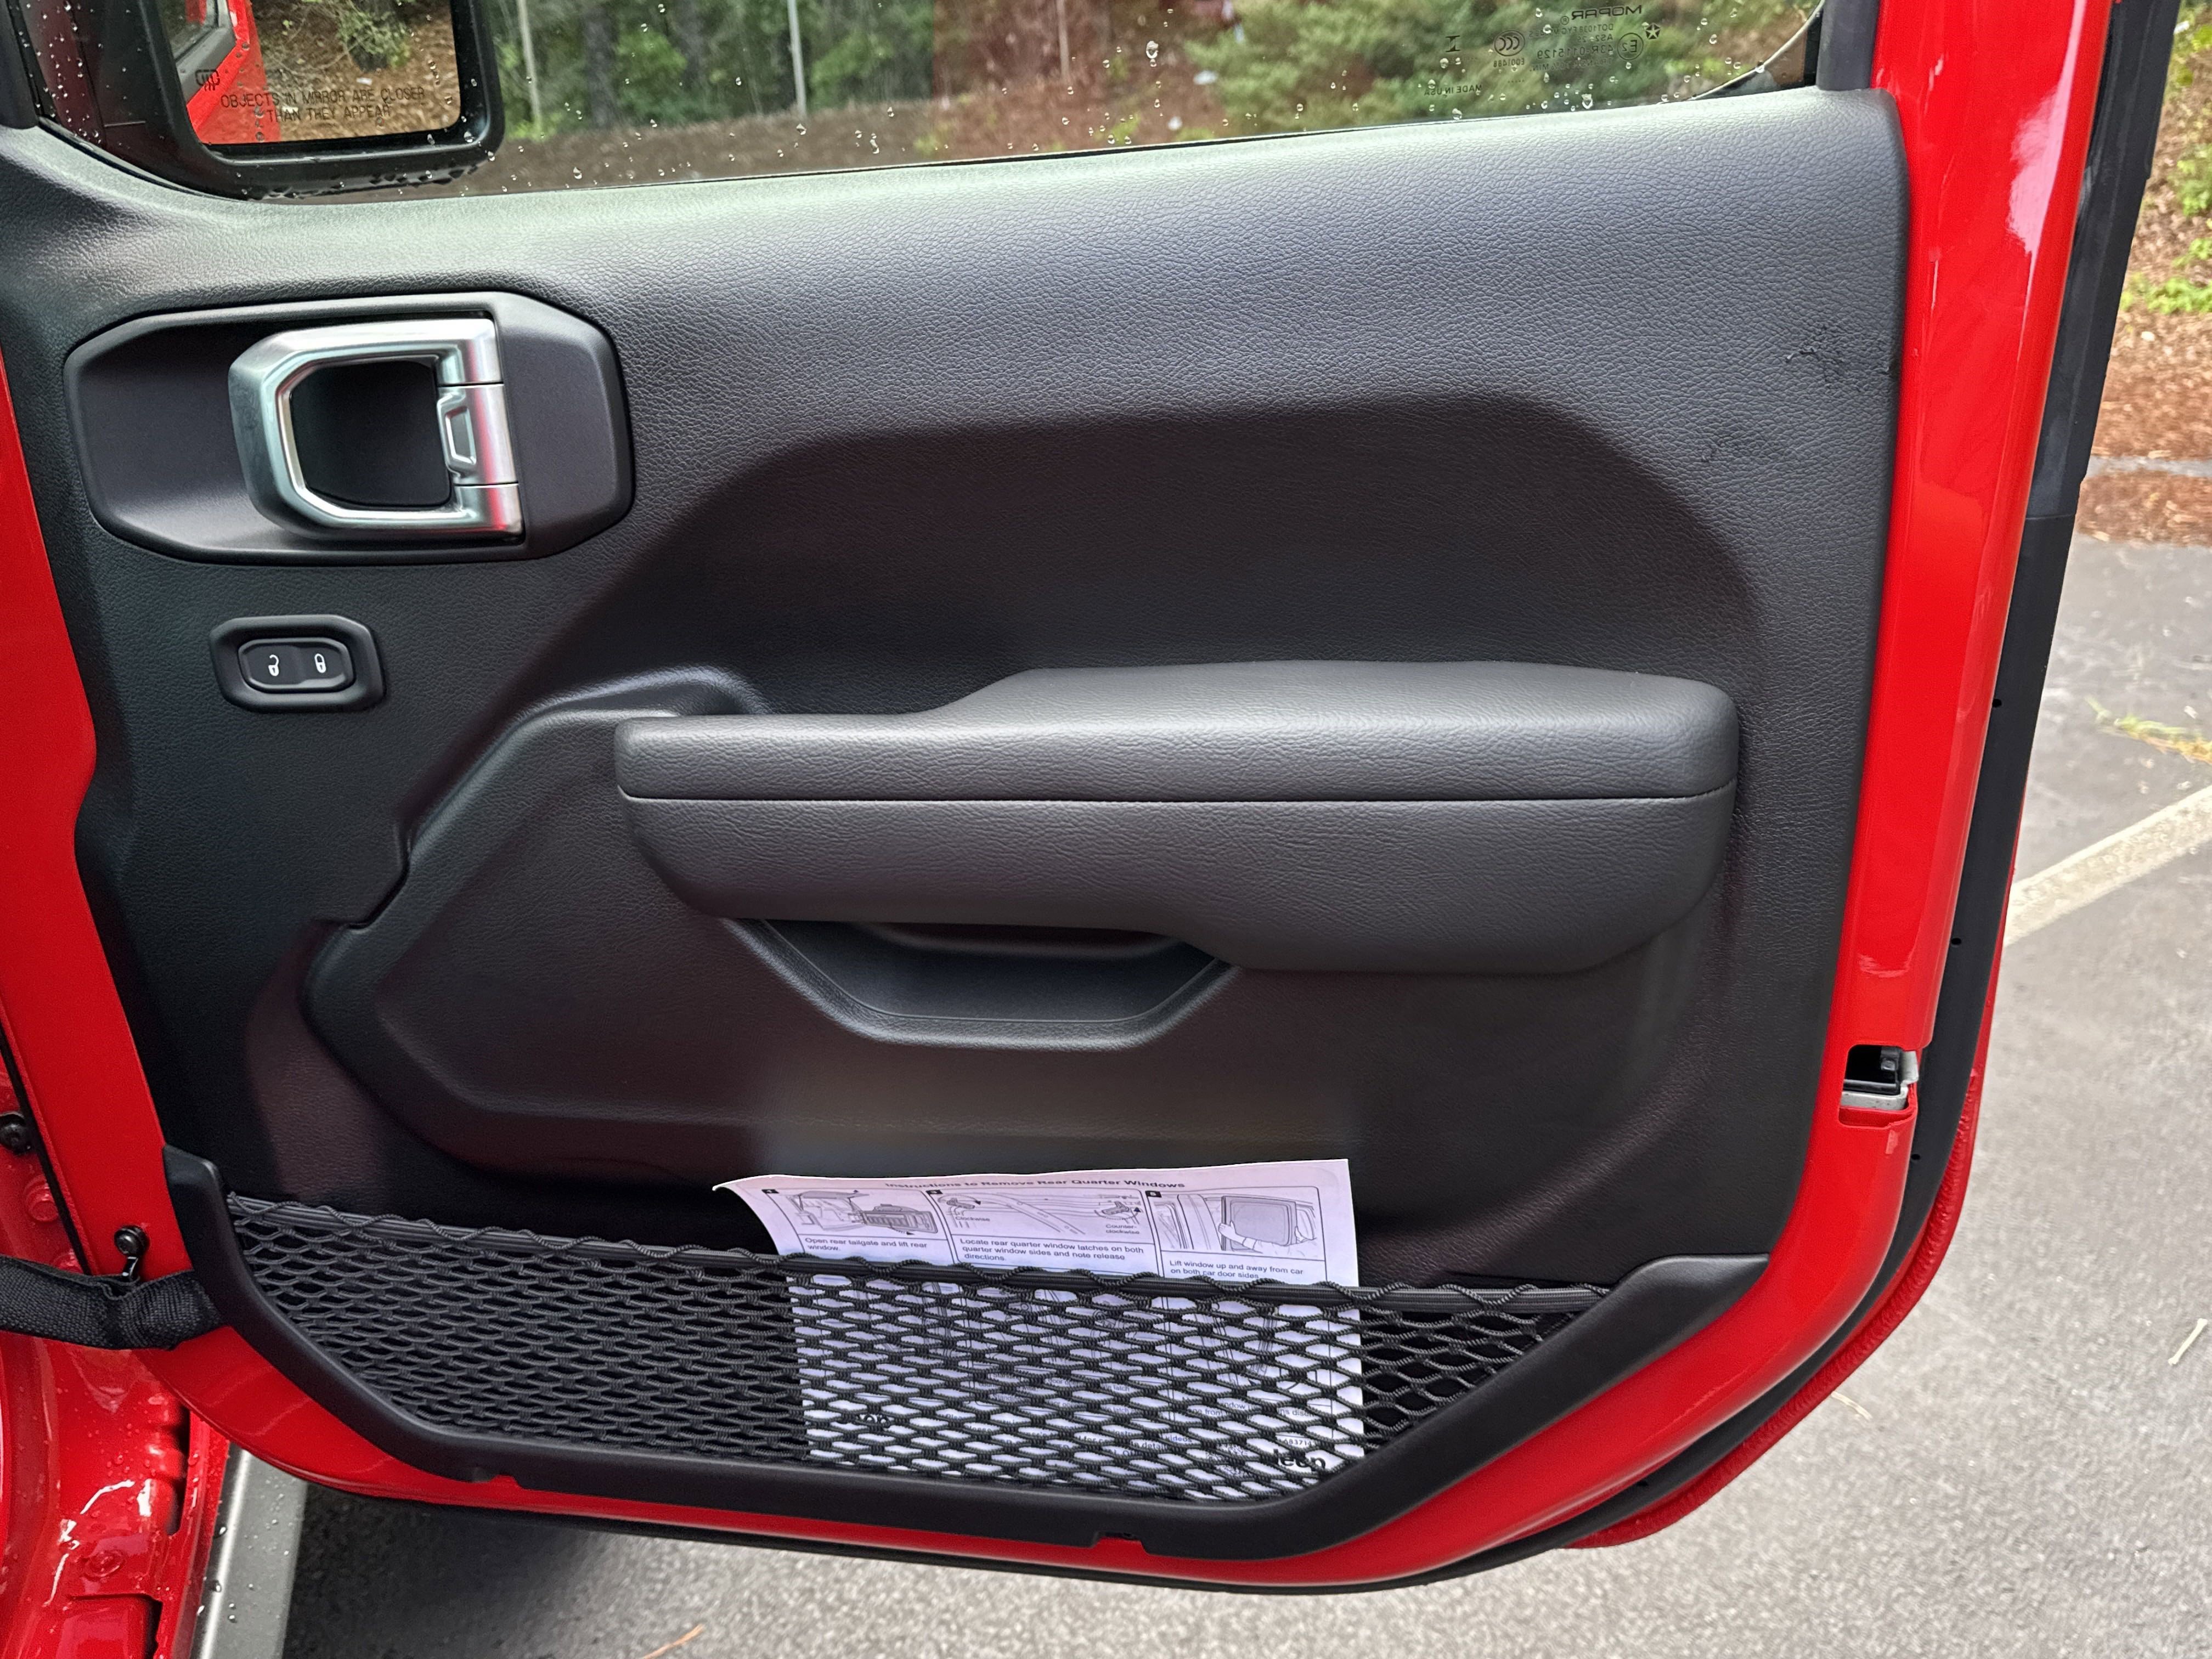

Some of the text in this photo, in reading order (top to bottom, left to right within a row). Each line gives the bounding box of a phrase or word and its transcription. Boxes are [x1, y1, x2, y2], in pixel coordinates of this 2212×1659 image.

[221, 86, 426, 108] OBJECTS IN MIRROR ARE CLOSER
[267, 104, 391, 122] THAN THEY APPEAR
[1124, 1180, 1185, 1188] Windows
[849, 1239, 879, 1247] tailgate
[964, 1253, 1007, 1261] directions.
